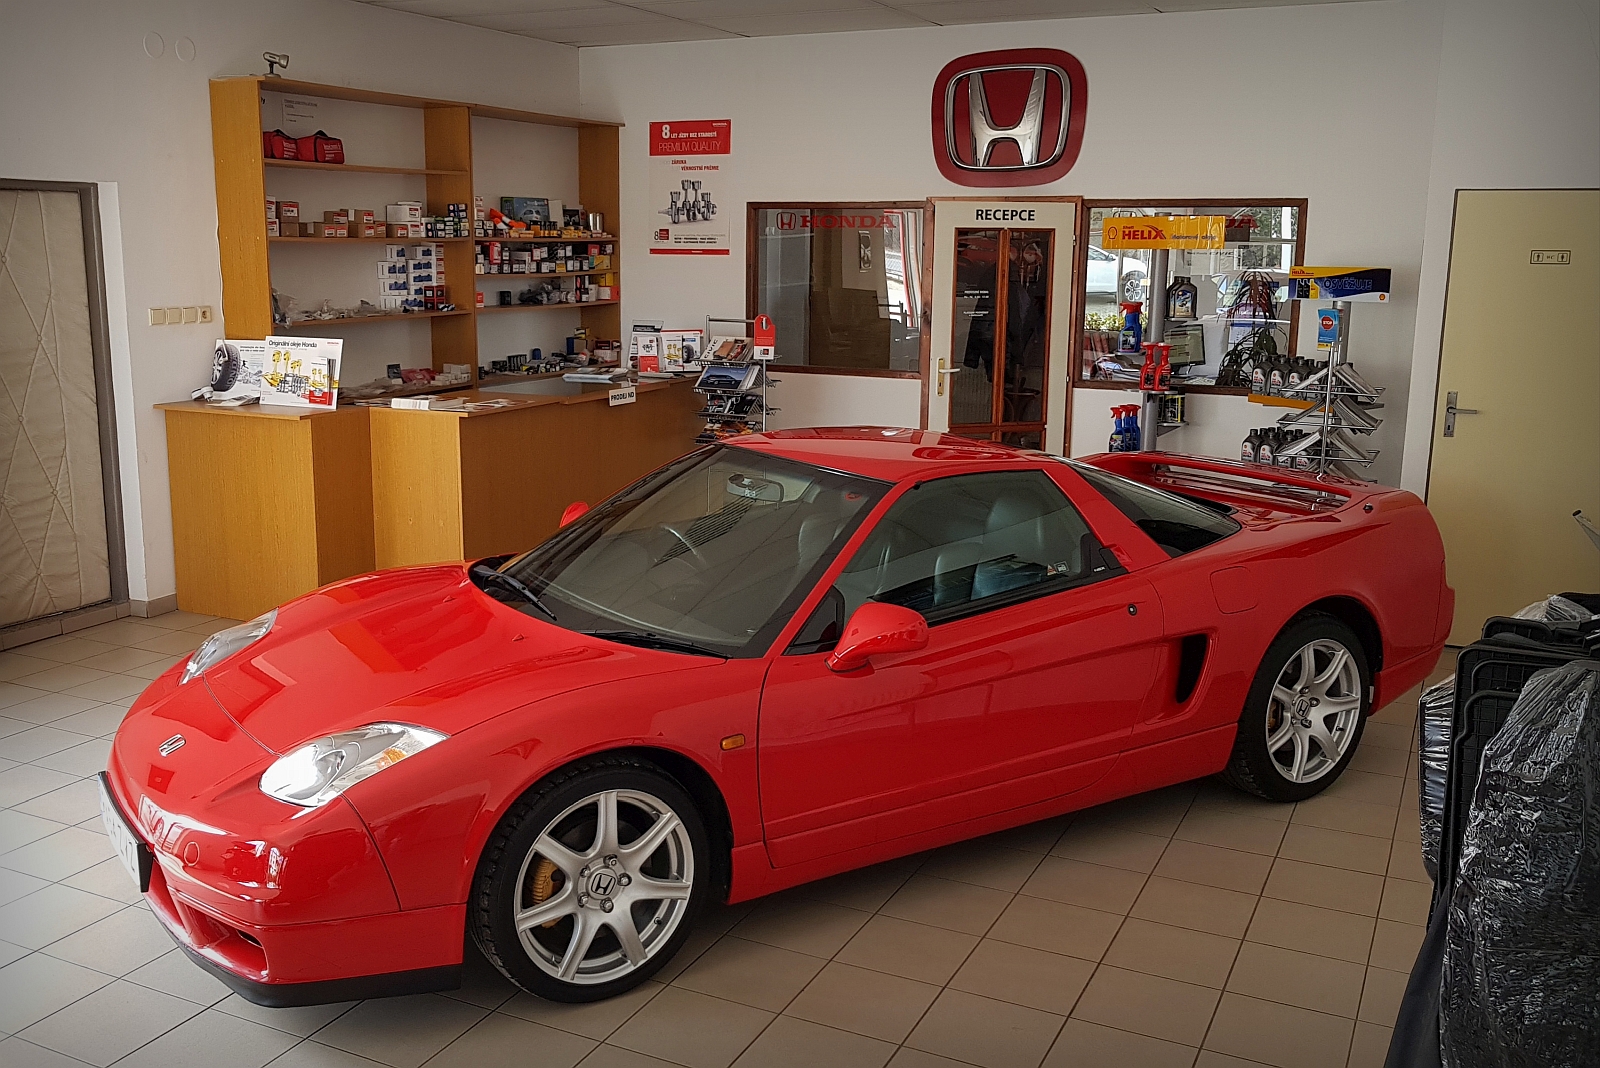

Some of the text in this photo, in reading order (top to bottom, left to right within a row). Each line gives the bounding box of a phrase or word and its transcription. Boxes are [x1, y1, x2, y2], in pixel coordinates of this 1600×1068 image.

[662, 124, 671, 139] 8
[658, 140, 721, 152] PREMIUM QUALITY
[975, 208, 1036, 221] RECEPCE
[800, 214, 896, 228] HONDA
[1122, 229, 1166, 240] HELIX
[610, 391, 635, 402] PRODEJ ND
